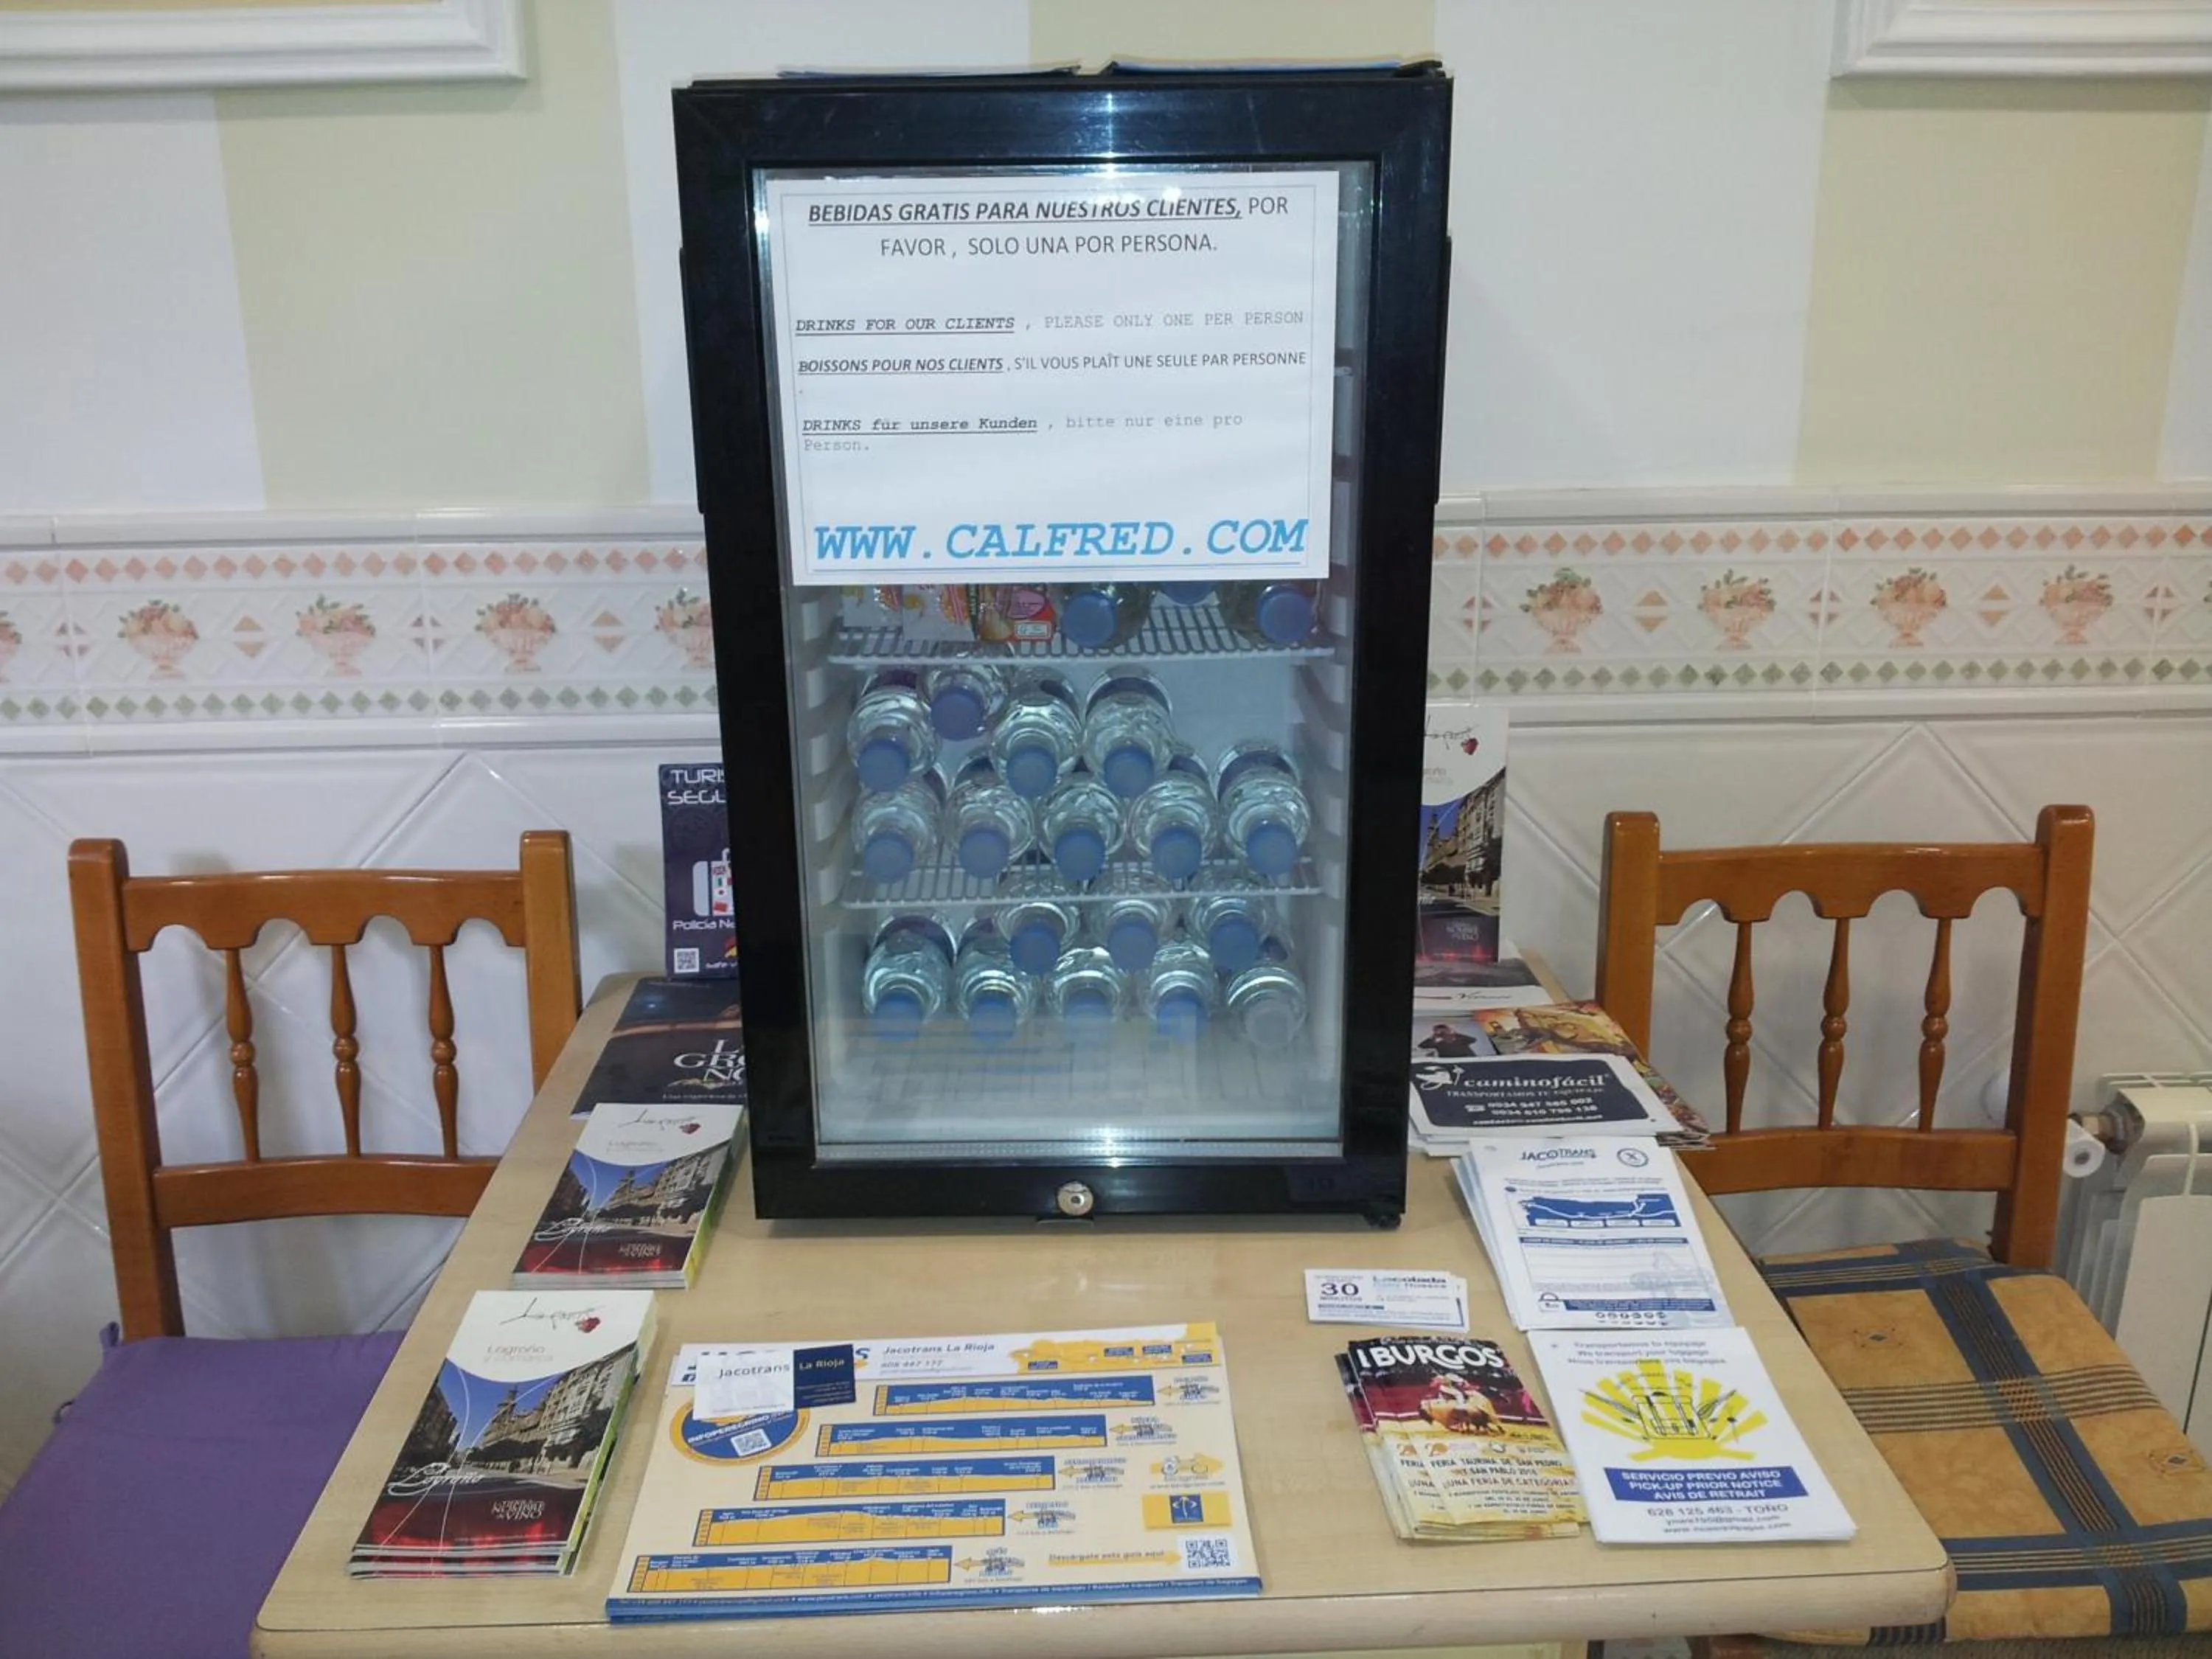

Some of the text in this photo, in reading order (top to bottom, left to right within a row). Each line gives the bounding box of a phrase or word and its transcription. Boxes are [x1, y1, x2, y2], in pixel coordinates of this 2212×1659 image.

[809, 196, 1289, 222] BEBIDAS GRATIS PARA NUESTROS CLIENTES, POR
[880, 234, 1218, 257] FAVOR SOLO UNA POR PERSONA.
[796, 310, 1304, 332] DRINKS FOR OUR CLIENTS PLEASE ONLY ONE PER PERSON
[799, 351, 1307, 372] BOISSONS POUR NOS CLIENTS S'IL VOUS PLAÎT UNE SEULE PAR PERSONNE
[802, 419, 862, 432] DRINKS
[910, 420, 969, 431] unsere
[978, 417, 1038, 430] Kunden
[1065, 415, 1116, 429] bitte
[1124, 417, 1155, 428] nur
[1164, 414, 1203, 428] eine
[1212, 414, 1244, 430] pro
[804, 437, 870, 453] Person.
[814, 518, 1309, 560] WWW.CALFRED.COM
[1321, 1282, 1359, 1296] 30
[1376, 1344, 1505, 1371] BURGOS
[718, 1358, 846, 1380] Jacotrans La Rioja
[1687, 1490, 1708, 1500] DE
